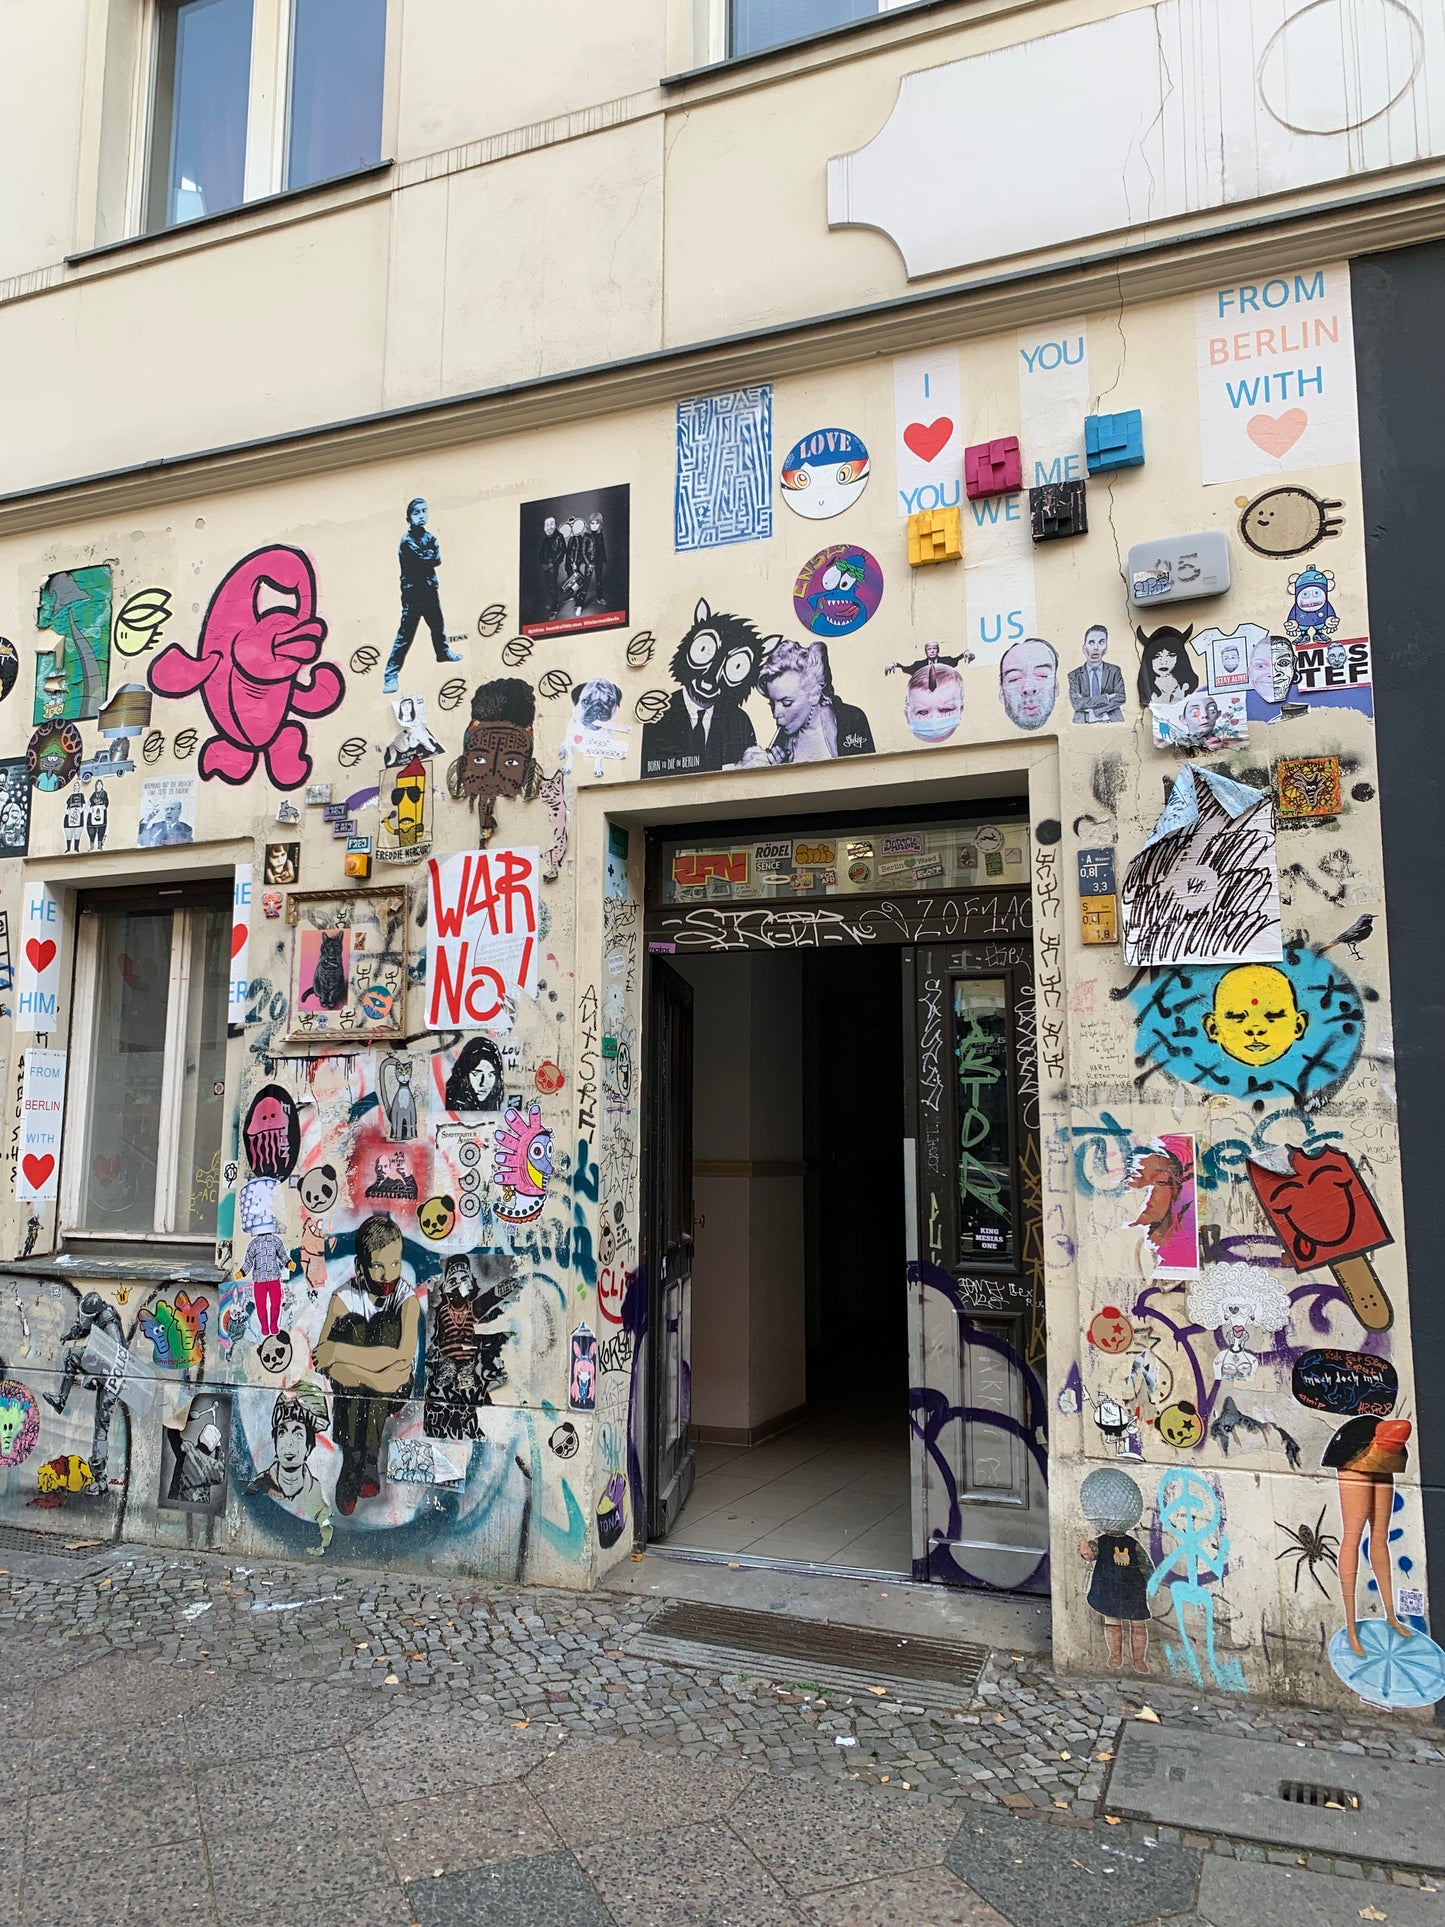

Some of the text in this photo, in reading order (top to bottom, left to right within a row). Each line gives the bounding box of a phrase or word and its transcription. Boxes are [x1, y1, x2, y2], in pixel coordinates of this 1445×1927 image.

[1218, 271, 1325, 318] FROM
[1209, 315, 1339, 366] BERLIN
[1020, 337, 1084, 373] YOU
[924, 373, 930, 398] I
[1226, 366, 1323, 410] WITH
[801, 432, 851, 459] LOVE
[1035, 455, 1081, 488] ME
[899, 480, 961, 514] YOU
[971, 493, 1021, 526] WE
[980, 610, 1024, 643] US
[1216, 673, 1247, 685] STAY ALIVE
[1299, 662, 1369, 687] TEF
[648, 760, 660, 772] BORN
[667, 758, 675, 770] DIE
[682, 755, 700, 768] BERLIN
[348, 839, 367, 848] FRED
[756, 843, 790, 858] RÖDEL
[375, 849, 403, 860] FREDDIE
[757, 861, 781, 872] SENCE
[881, 863, 905, 873] Berlin
[427, 851, 536, 938] WAR
[30, 899, 57, 923] HE
[1082, 902, 1088, 911] S
[19, 991, 55, 1015] HIM
[30, 1066, 60, 1079] FROM
[25, 1100, 61, 1111] BERLIN
[26, 1132, 55, 1144] WITH
[975, 1234, 1004, 1243] MESIAS
[980, 1227, 999, 1236] KING
[981, 1242, 997, 1250] ONE
[1335, 1371, 1359, 1387] doch
[600, 1510, 620, 1532] TONA
